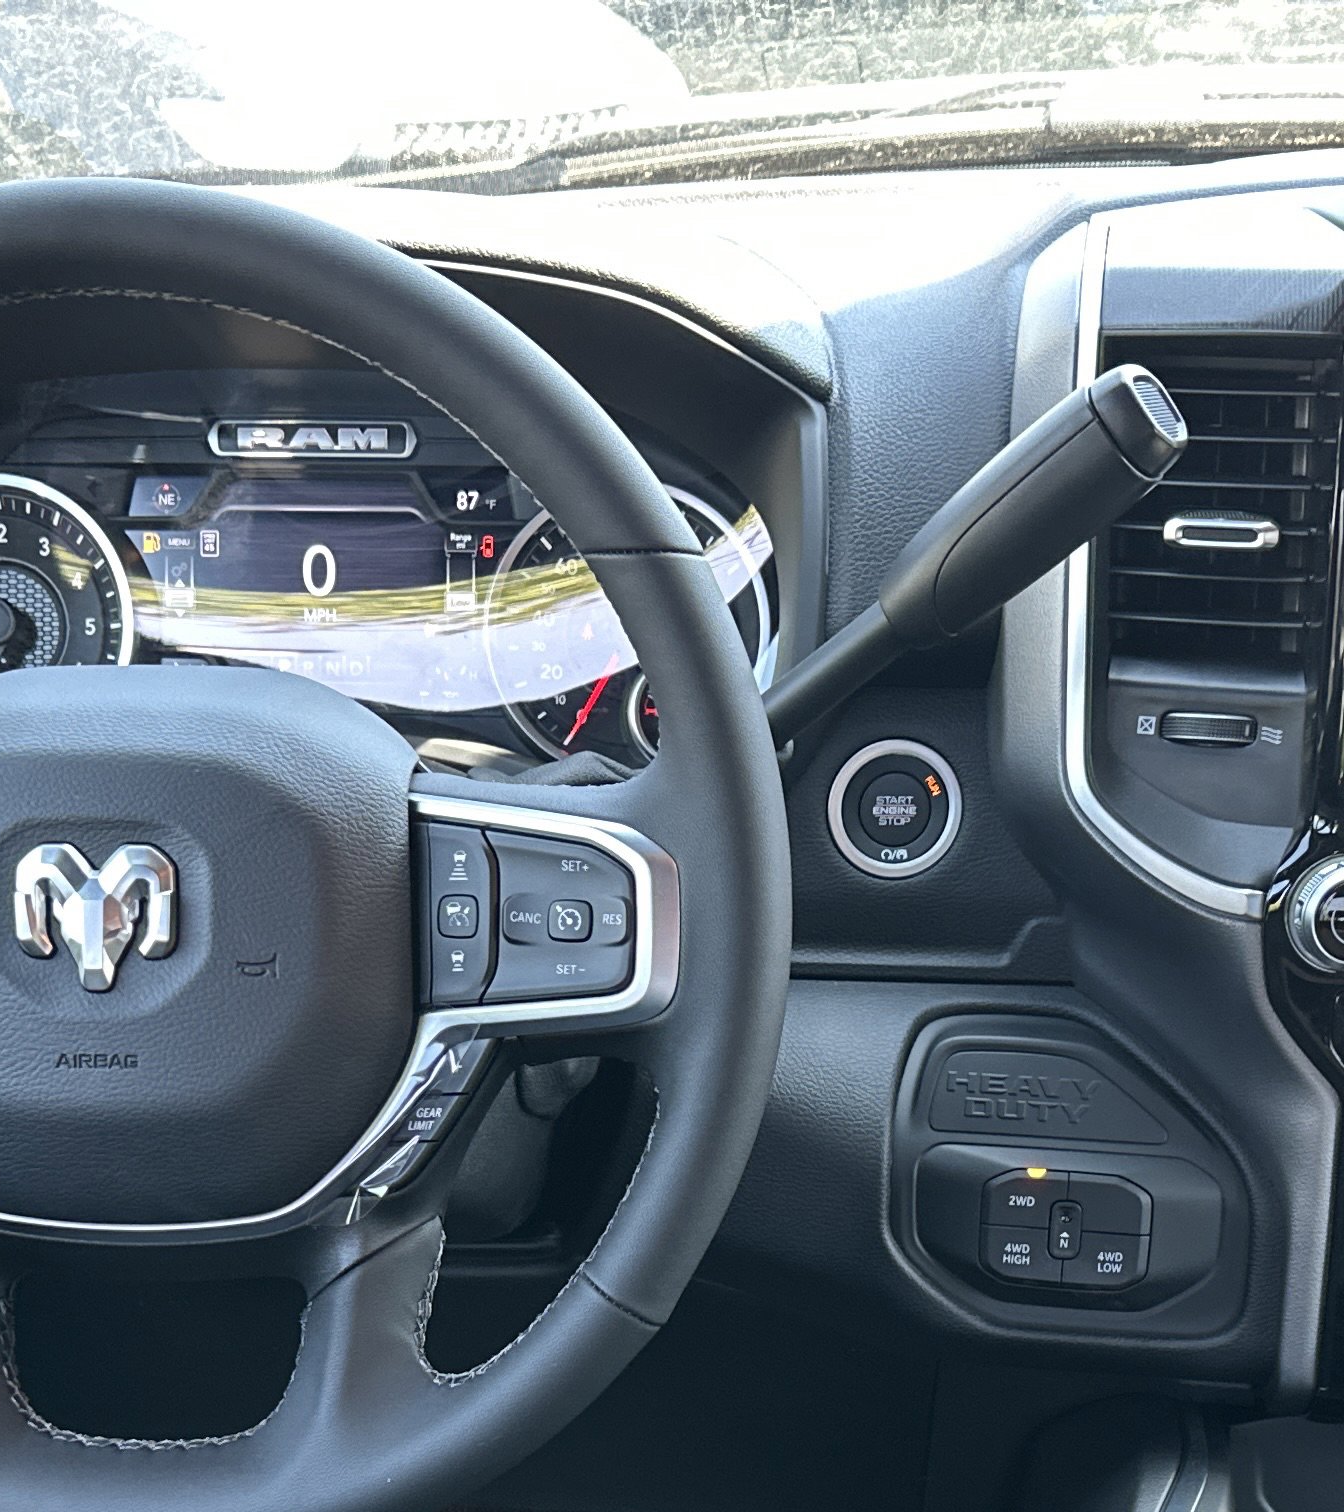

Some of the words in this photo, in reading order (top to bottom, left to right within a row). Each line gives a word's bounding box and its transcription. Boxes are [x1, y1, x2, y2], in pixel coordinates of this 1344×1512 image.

[236, 427, 389, 451] RAM
[158, 493, 176, 506] NE
[456, 490, 479, 511] 87
[39, 537, 50, 557] 3
[167, 538, 191, 547] MENU
[302, 544, 336, 597] 0
[555, 557, 578, 576] 60
[71, 572, 83, 590] 4
[303, 607, 337, 623] MPH
[85, 617, 96, 635] 5
[540, 663, 563, 681] 20
[555, 694, 567, 706] 10
[924, 775, 942, 797] RUN
[876, 795, 914, 805] START
[872, 806, 918, 815] ENGINE
[878, 816, 912, 826] STOP
[510, 911, 542, 925] CANC
[602, 913, 623, 926] RES
[56, 1053, 139, 1069] AIRBAG
[945, 1070, 1102, 1101] HEAVY
[416, 1107, 443, 1118] GEAR
[963, 1096, 1091, 1124] DUTY
[408, 1120, 434, 1131] LIMIT
[1008, 1195, 1035, 1208] 2WD
[1004, 1243, 1030, 1255] 4WD
[1059, 1239, 1069, 1249] N
[1002, 1253, 1031, 1265] HIGH
[1097, 1251, 1123, 1263] 4WD
[1097, 1262, 1123, 1273] LOW
